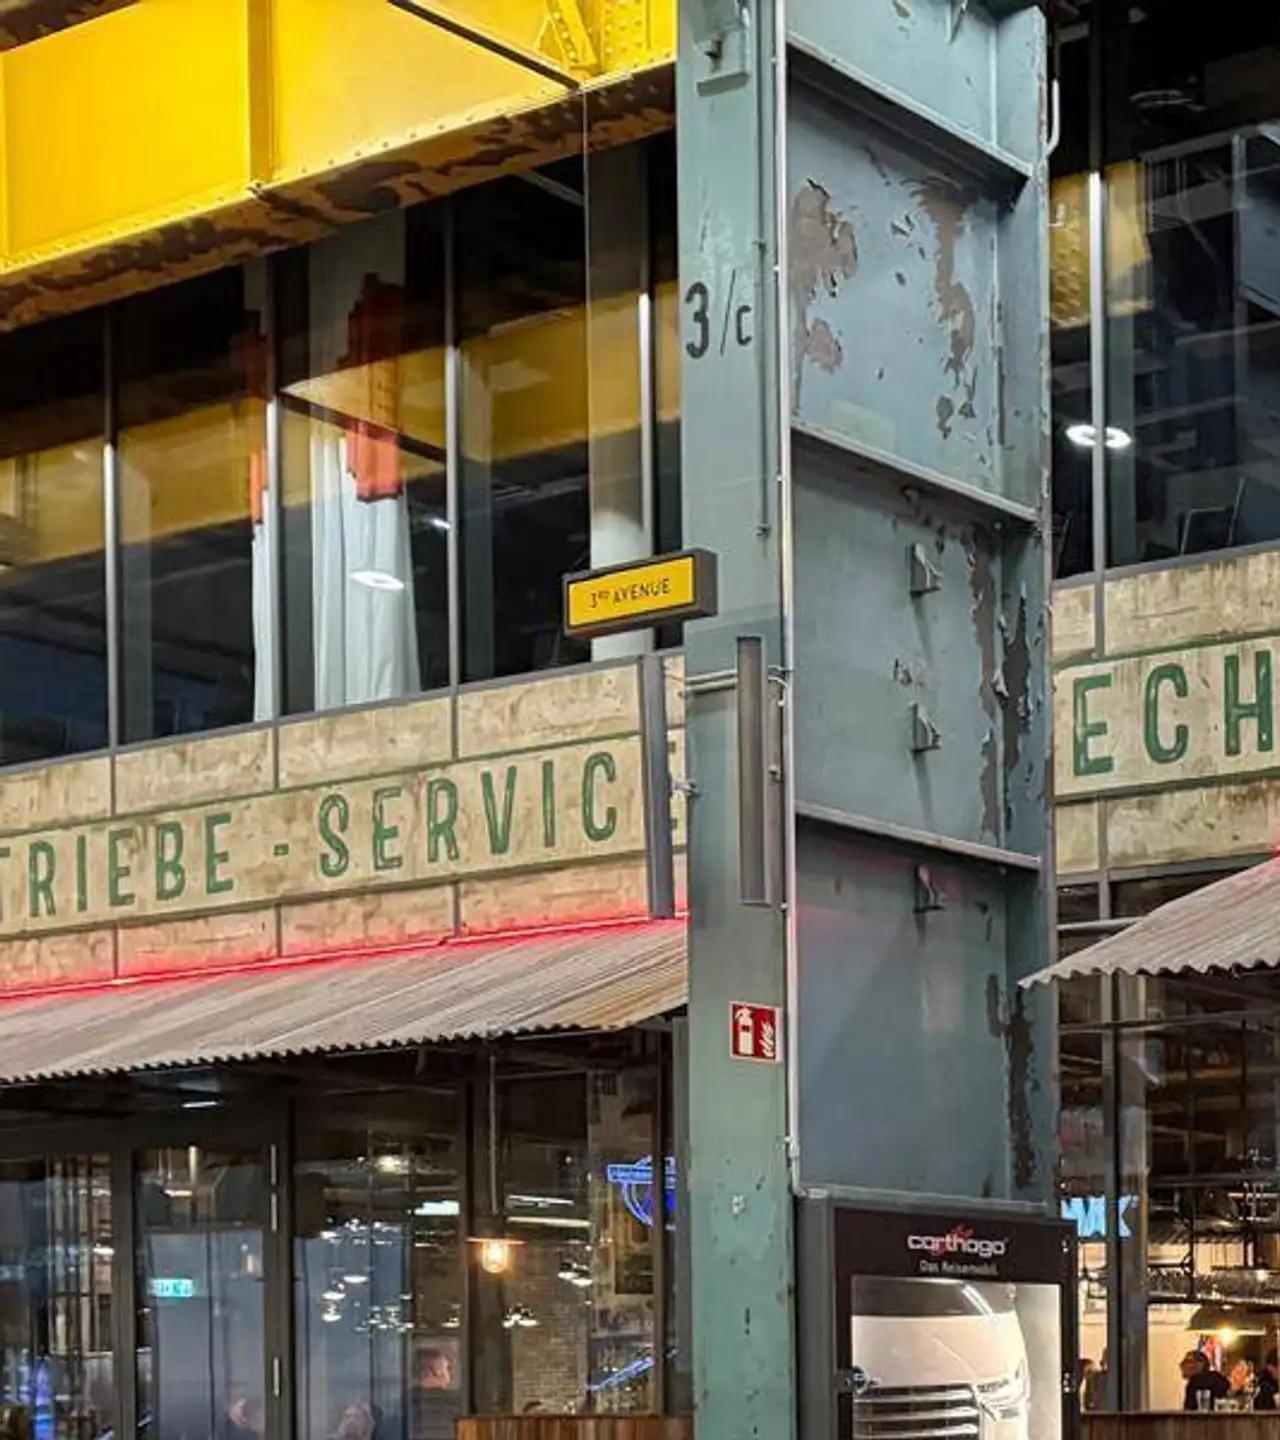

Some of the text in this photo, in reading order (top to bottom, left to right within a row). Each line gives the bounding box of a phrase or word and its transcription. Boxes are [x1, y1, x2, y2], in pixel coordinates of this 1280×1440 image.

[613, 577, 671, 604] AVENUE
[318, 741, 677, 878] SERVIC
[907, 1232, 1006, 1258] carthago
